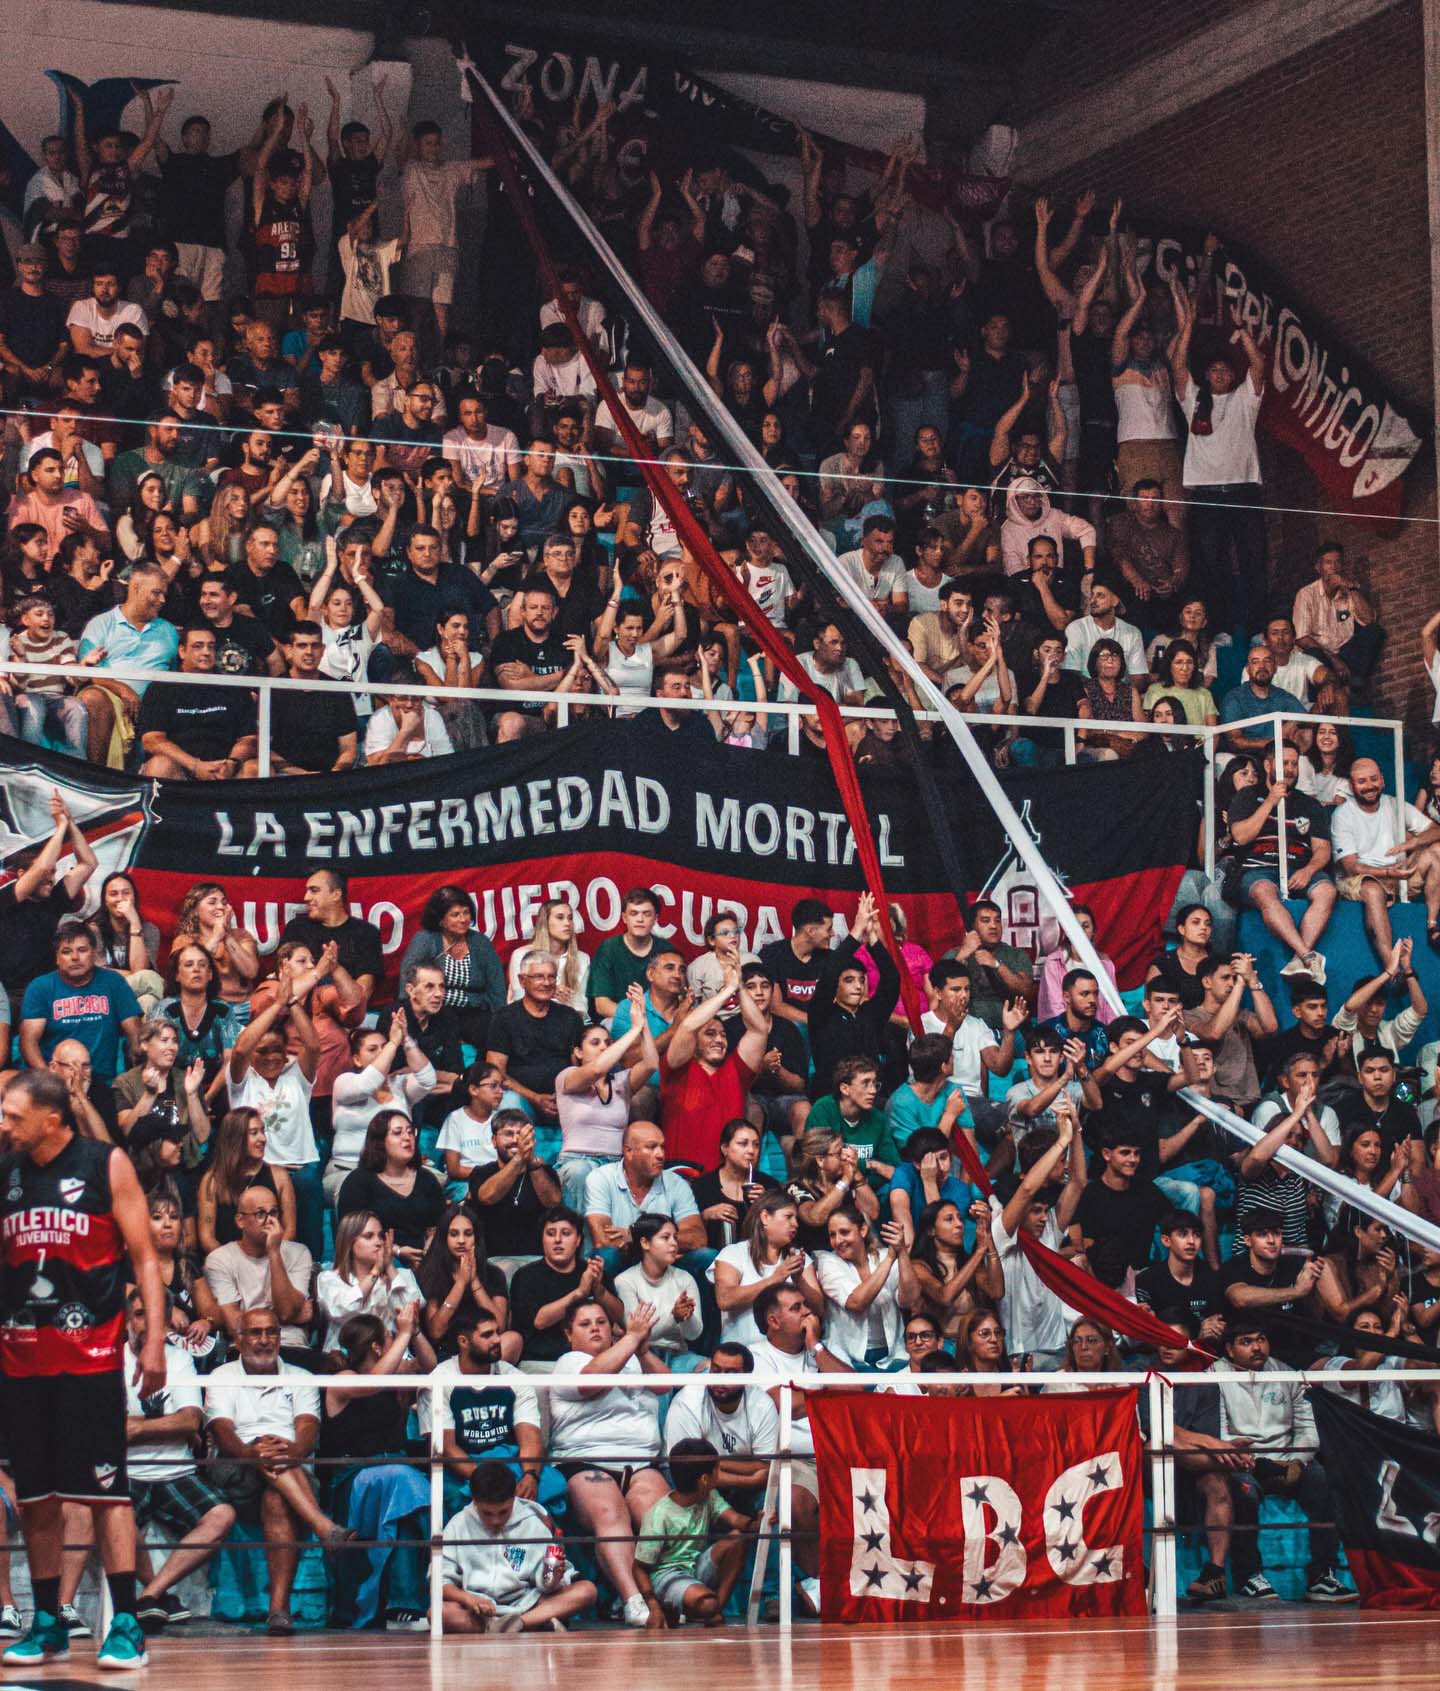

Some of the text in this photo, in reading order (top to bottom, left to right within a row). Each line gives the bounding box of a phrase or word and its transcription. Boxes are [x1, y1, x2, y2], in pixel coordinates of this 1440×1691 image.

[501, 44, 648, 112] ZONA
[214, 811, 287, 857] LA
[303, 769, 670, 858] ENFERMEDAD
[469, 876, 622, 944] UIERO
[53, 995, 110, 1020] CHICAGO
[3, 1206, 90, 1238] ATLETICO
[16, 1230, 71, 1248] JUVENTUS
[461, 1404, 507, 1424] RUSTY
[463, 1425, 509, 1439] WORLDWIDE
